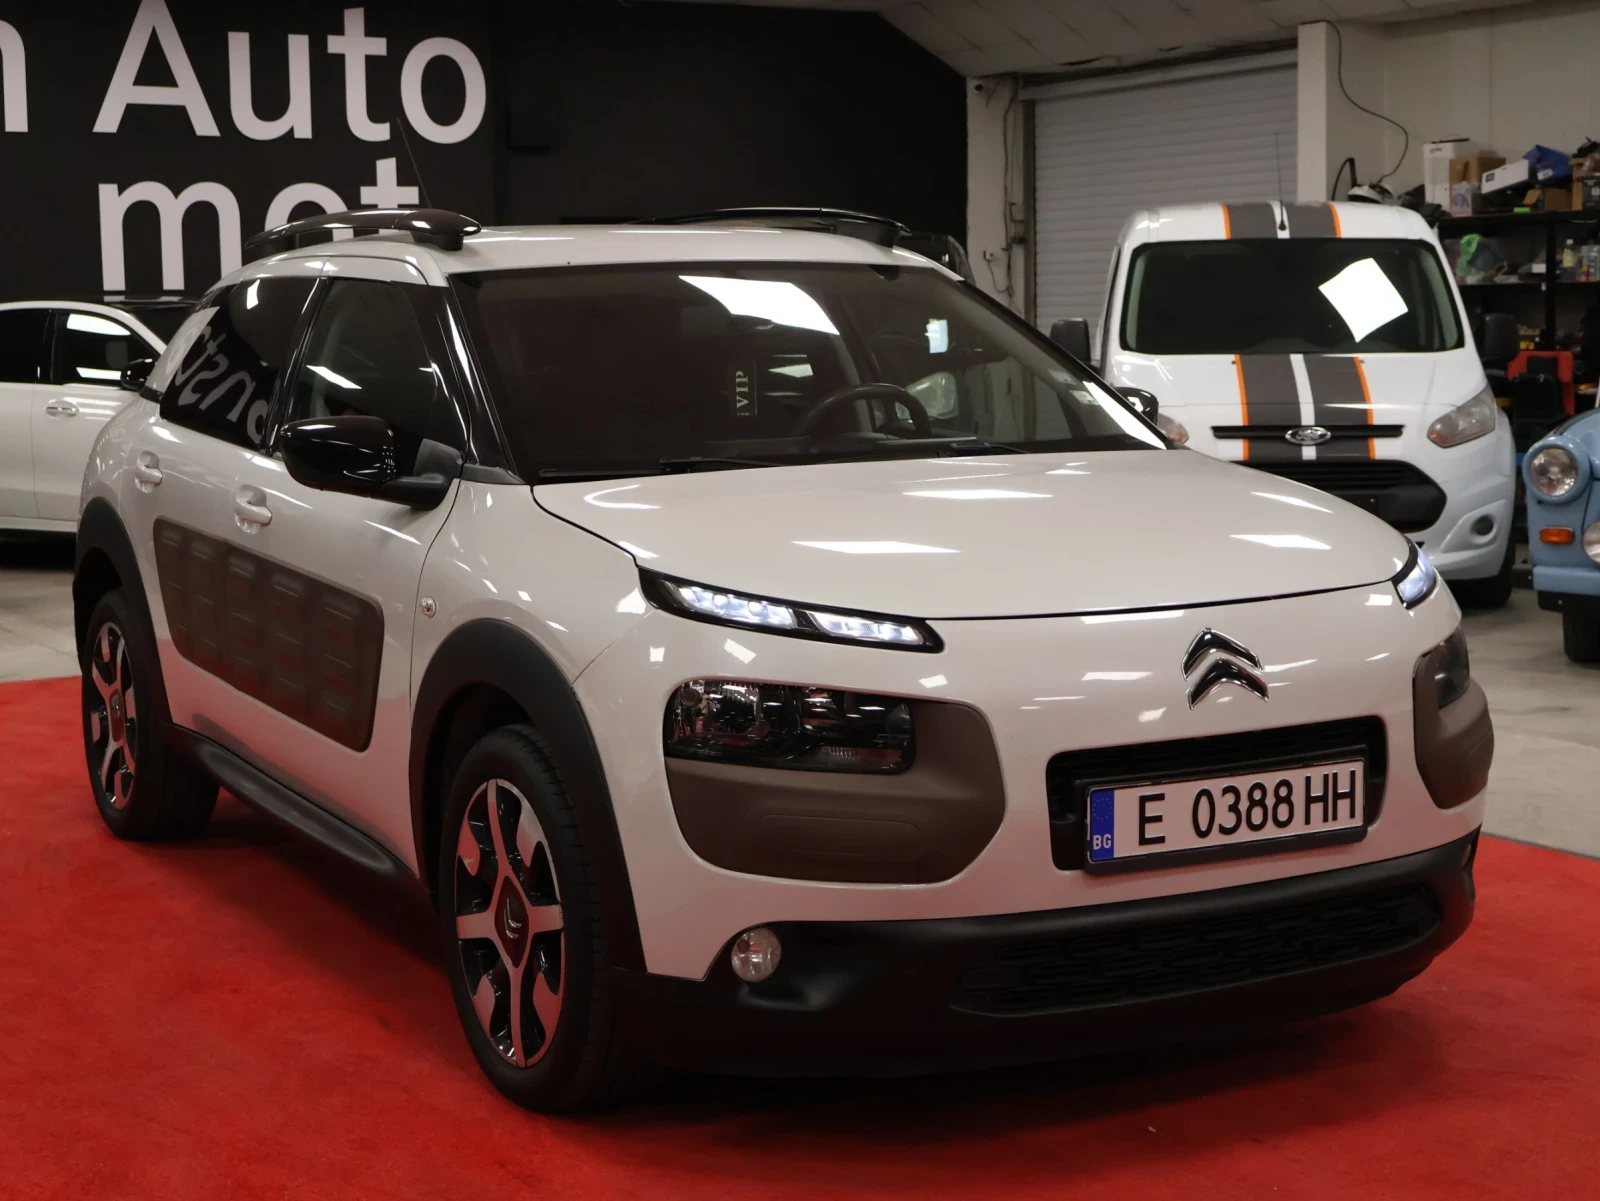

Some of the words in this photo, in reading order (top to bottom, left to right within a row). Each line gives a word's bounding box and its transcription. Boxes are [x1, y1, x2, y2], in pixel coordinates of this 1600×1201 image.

[93, 0, 487, 144] Auto
[735, 370, 749, 409] VIP
[1138, 793, 1166, 846] E
[1192, 779, 1294, 838] 0388
[1304, 769, 1356, 826] HH
[1093, 833, 1112, 850] BG
